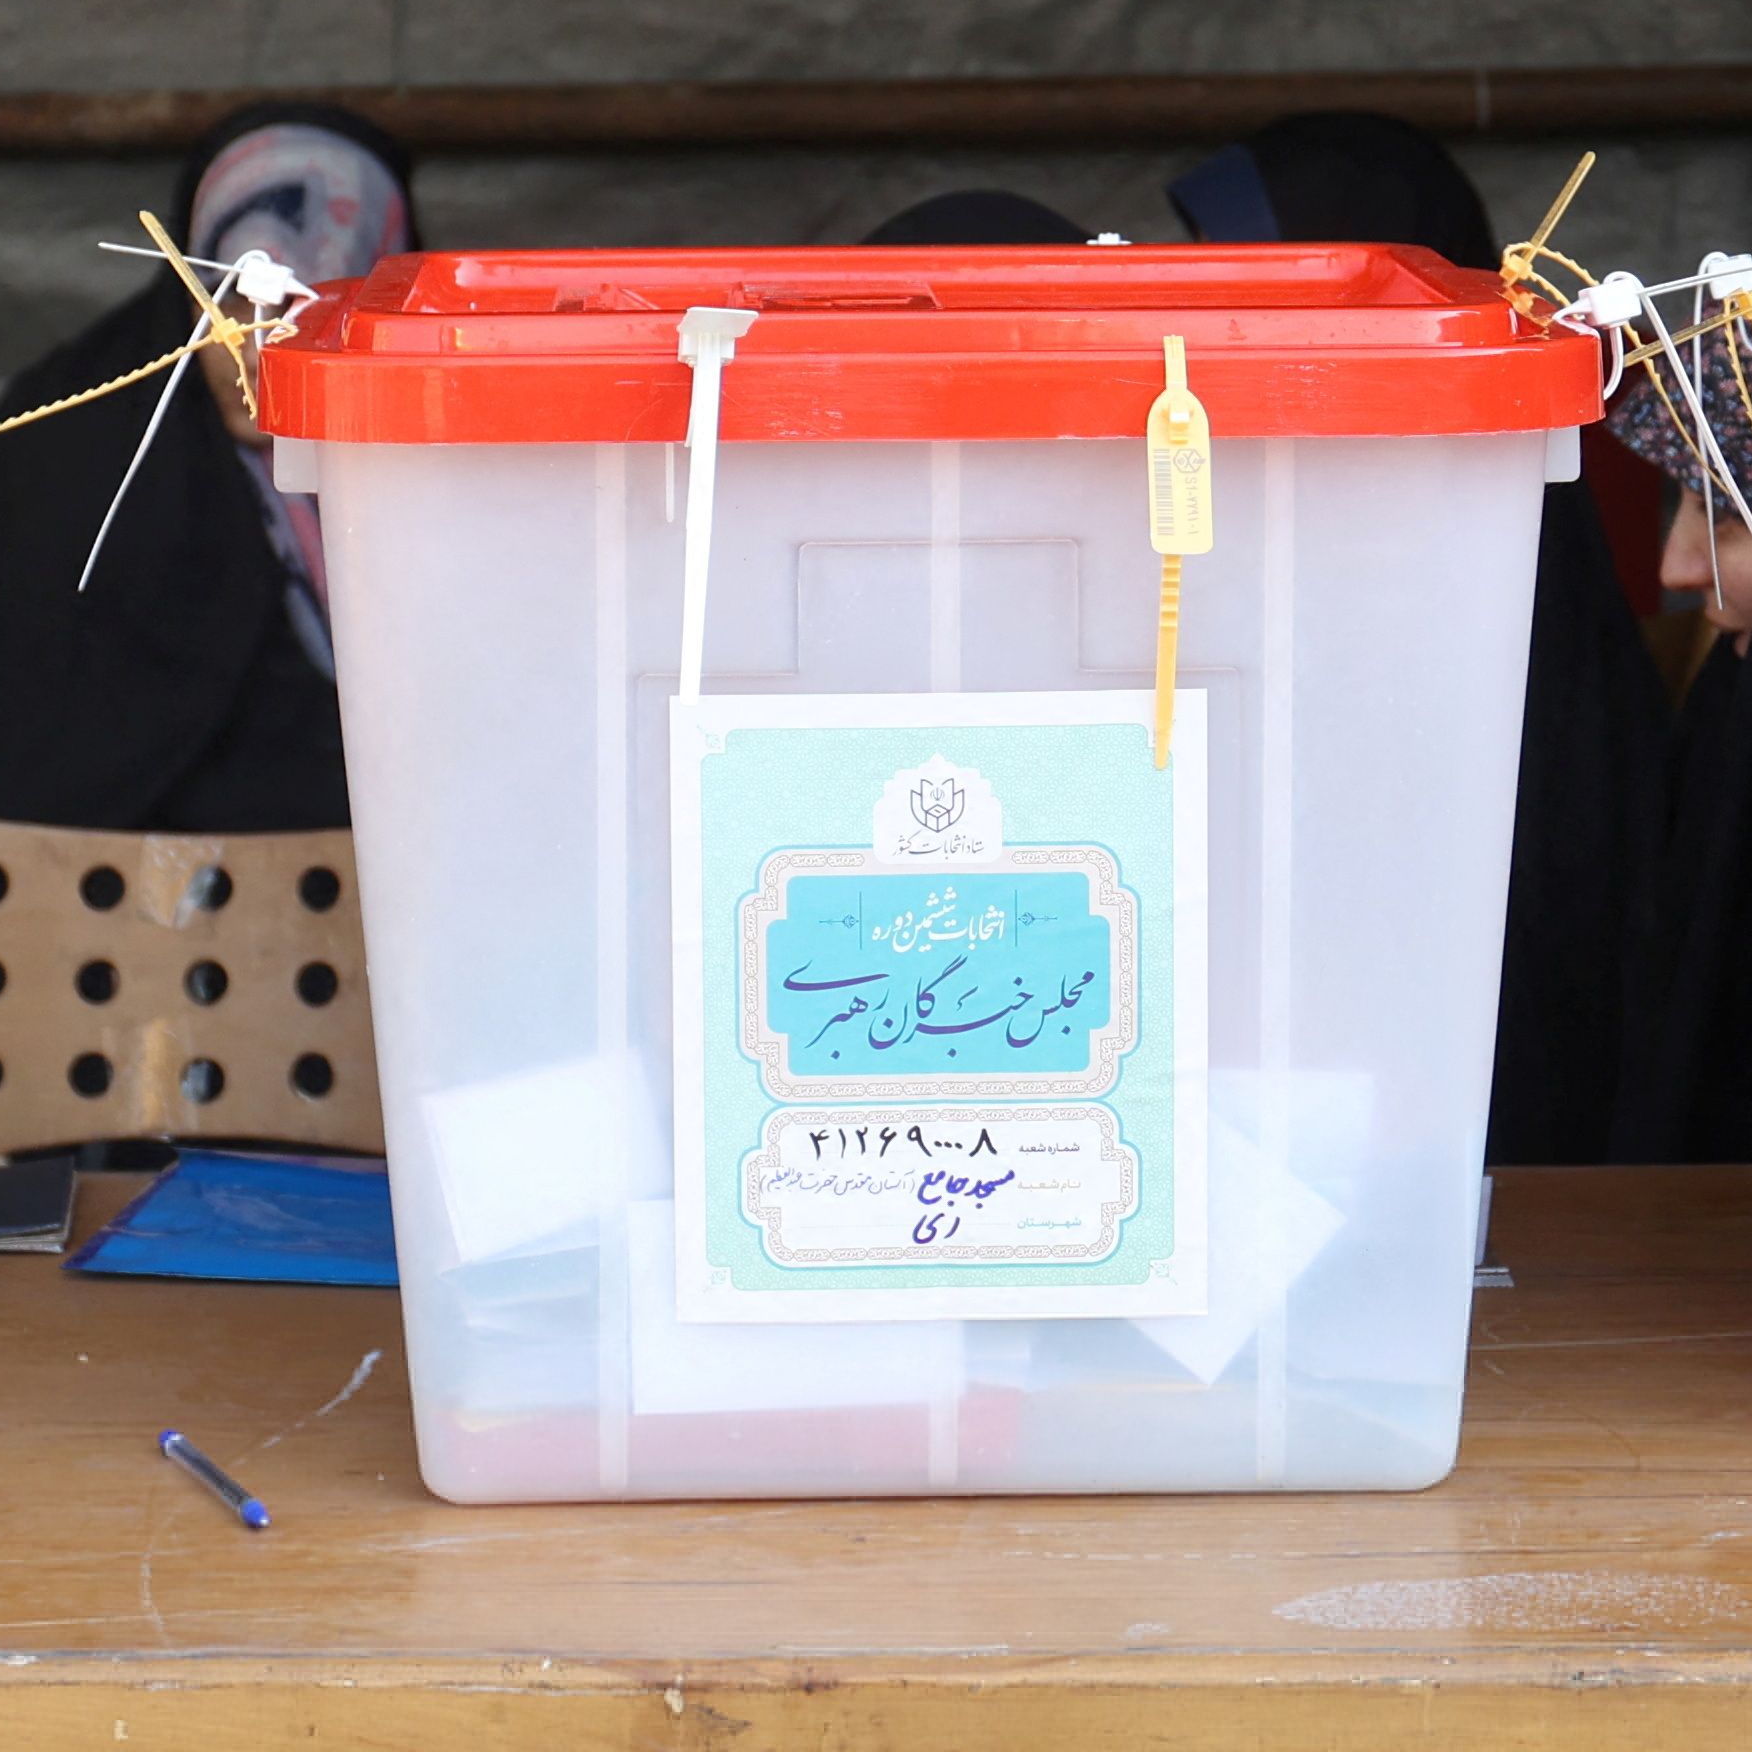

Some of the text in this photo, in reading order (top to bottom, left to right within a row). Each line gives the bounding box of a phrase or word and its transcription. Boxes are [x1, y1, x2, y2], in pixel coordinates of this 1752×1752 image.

[892, 830, 985, 859] ستاد انتخابات کشور
[871, 886, 1007, 954] انتخابات ششمین دوره
[782, 953, 1096, 1061] مجلس خبرگان رهبری
[1018, 1142, 1081, 1155] شماره شعبه
[916, 1170, 971, 1206] جامع
[964, 1169, 1016, 1209] مسجد
[1017, 1178, 1081, 1193] نام شعبه
[912, 1212, 961, 1245] ری
[1016, 1215, 1083, 1230] شهرستان
